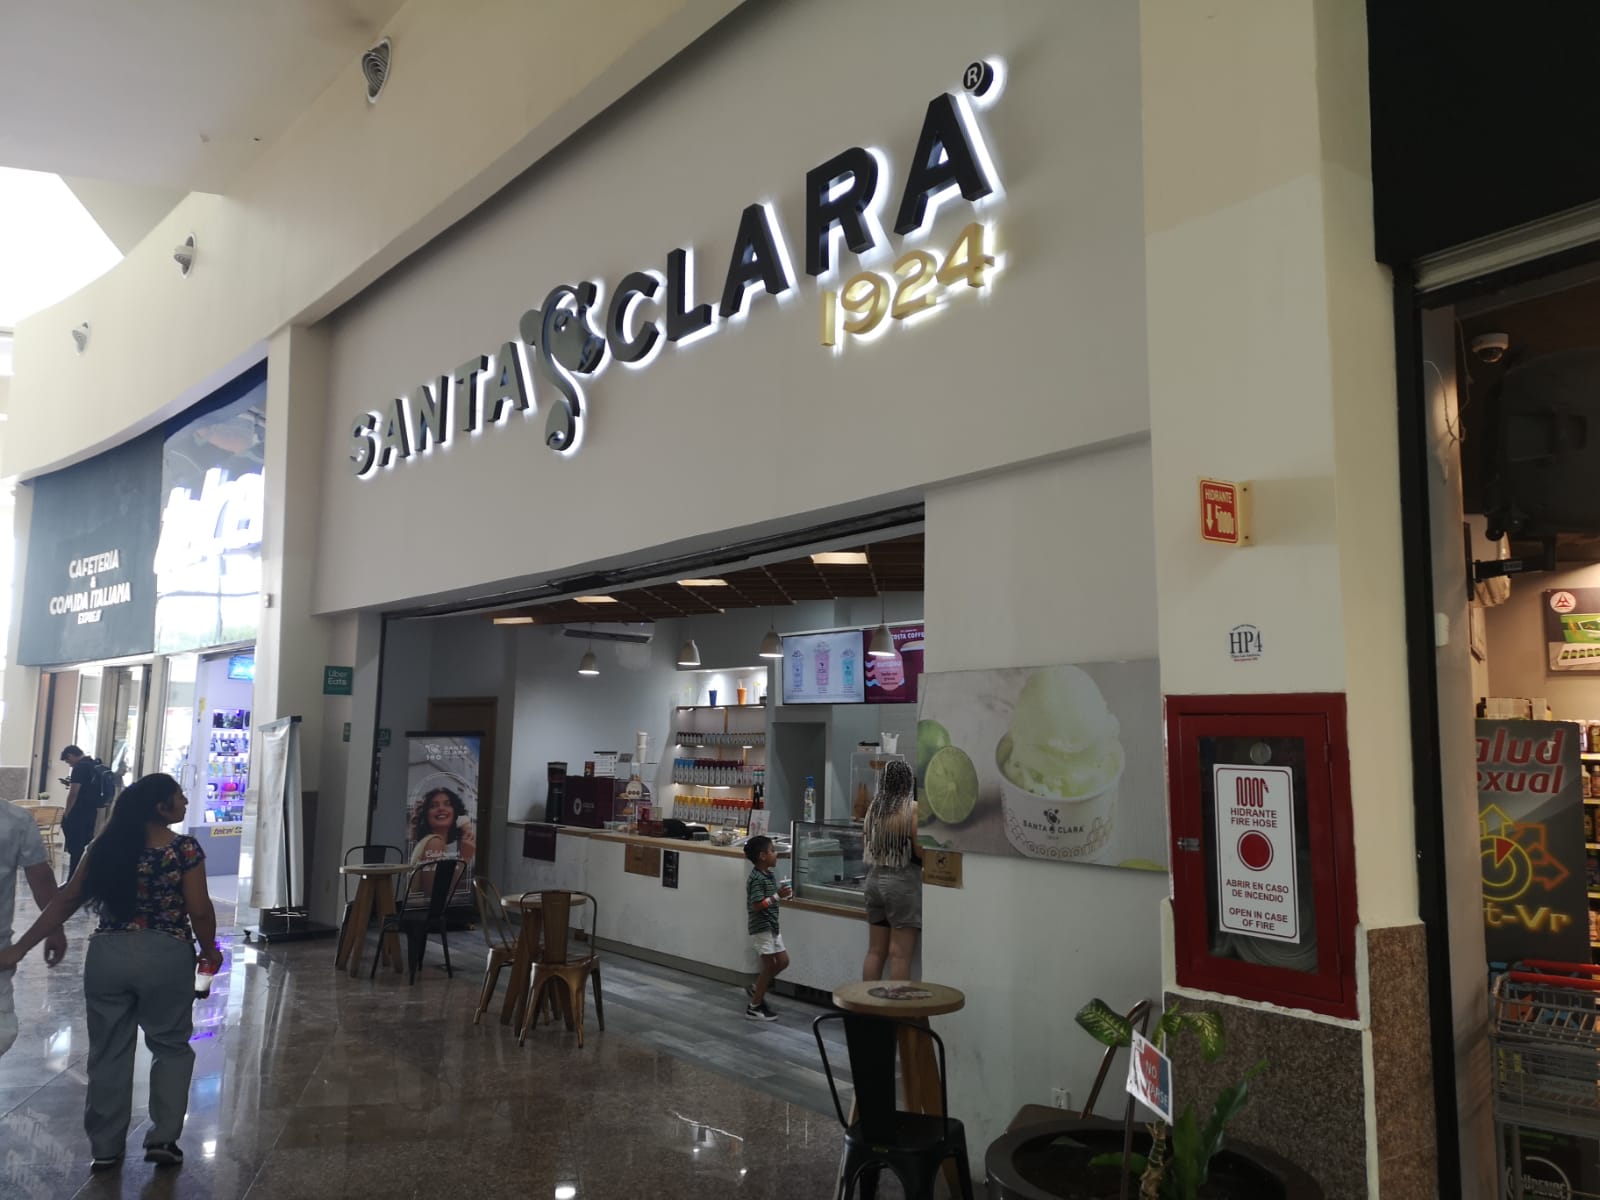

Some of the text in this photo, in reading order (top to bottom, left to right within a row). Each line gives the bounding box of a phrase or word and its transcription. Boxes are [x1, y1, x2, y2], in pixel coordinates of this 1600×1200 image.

[349, 340, 532, 476] SANTA
[607, 92, 995, 364] CLARA
[819, 221, 998, 348] 1924
[1205, 488, 1233, 504] HIDRANTE
[69, 549, 119, 579] CAFETERIA
[50, 582, 131, 615] COMIDA ITALIANA
[1229, 630, 1263, 654] HP4
[327, 677, 348, 686] Eats
[328, 669, 348, 678] Uber
[1230, 807, 1277, 819] HIDRANTE
[1022, 819, 1084, 835] SANTA CLARA
[1230, 817, 1278, 829] FIRE HOSE
[1226, 878, 1290, 895] ABRIR EN CASO
[1231, 888, 1283, 903] DE INCENDIO
[1229, 907, 1288, 924] OPEN IN CASE
[1242, 918, 1276, 932] OF FIRE
[1145, 1060, 1158, 1080] NO
